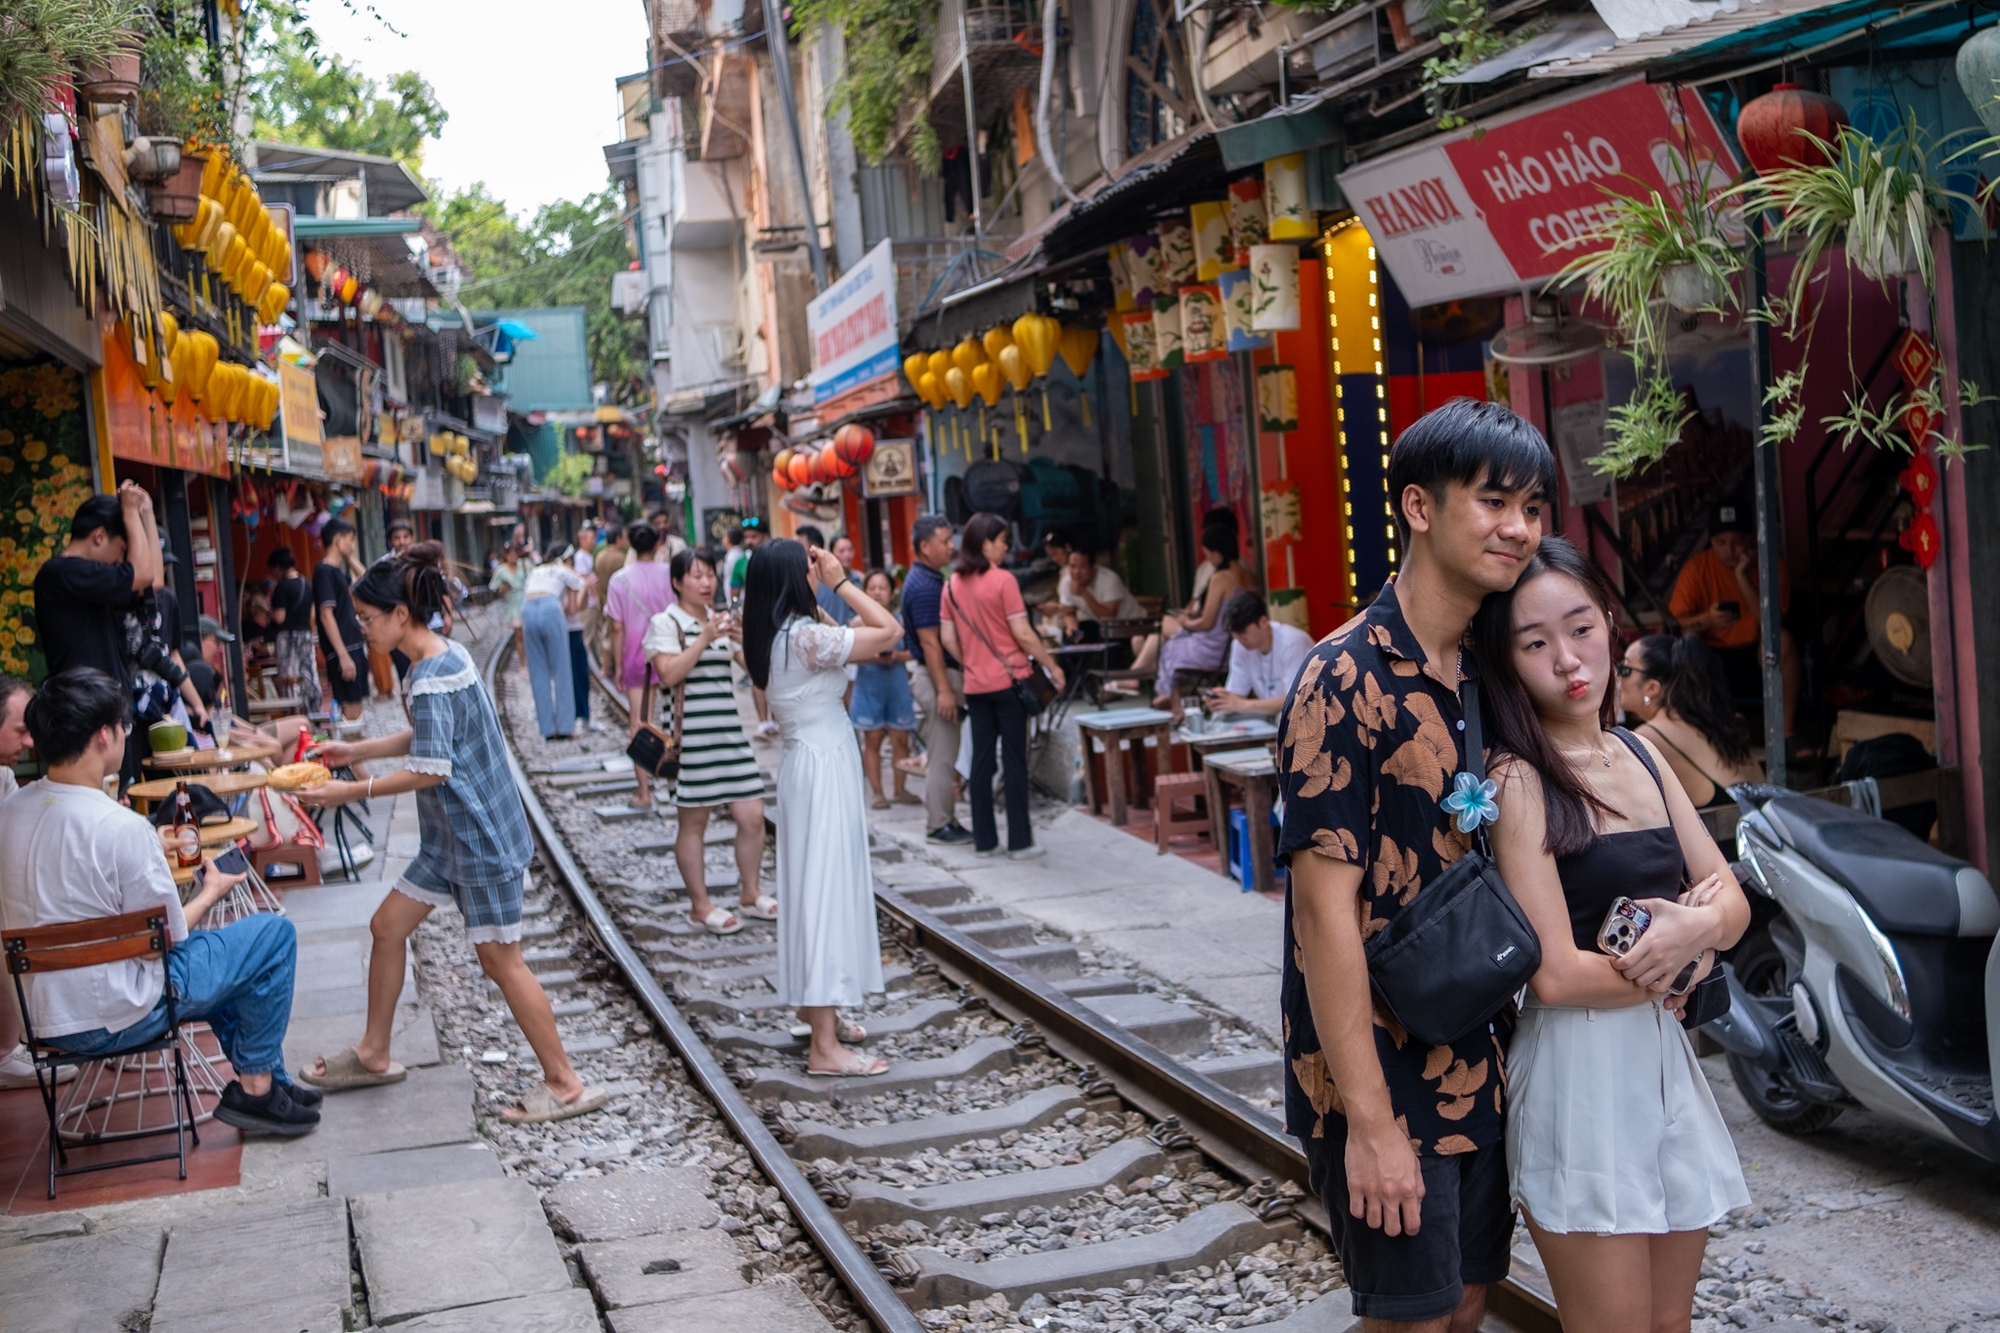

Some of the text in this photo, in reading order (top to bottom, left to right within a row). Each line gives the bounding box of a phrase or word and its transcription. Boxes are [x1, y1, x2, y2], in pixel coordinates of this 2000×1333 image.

[1482, 131, 1622, 204] HẢO HẢO
[1365, 176, 1464, 238] HANOI
